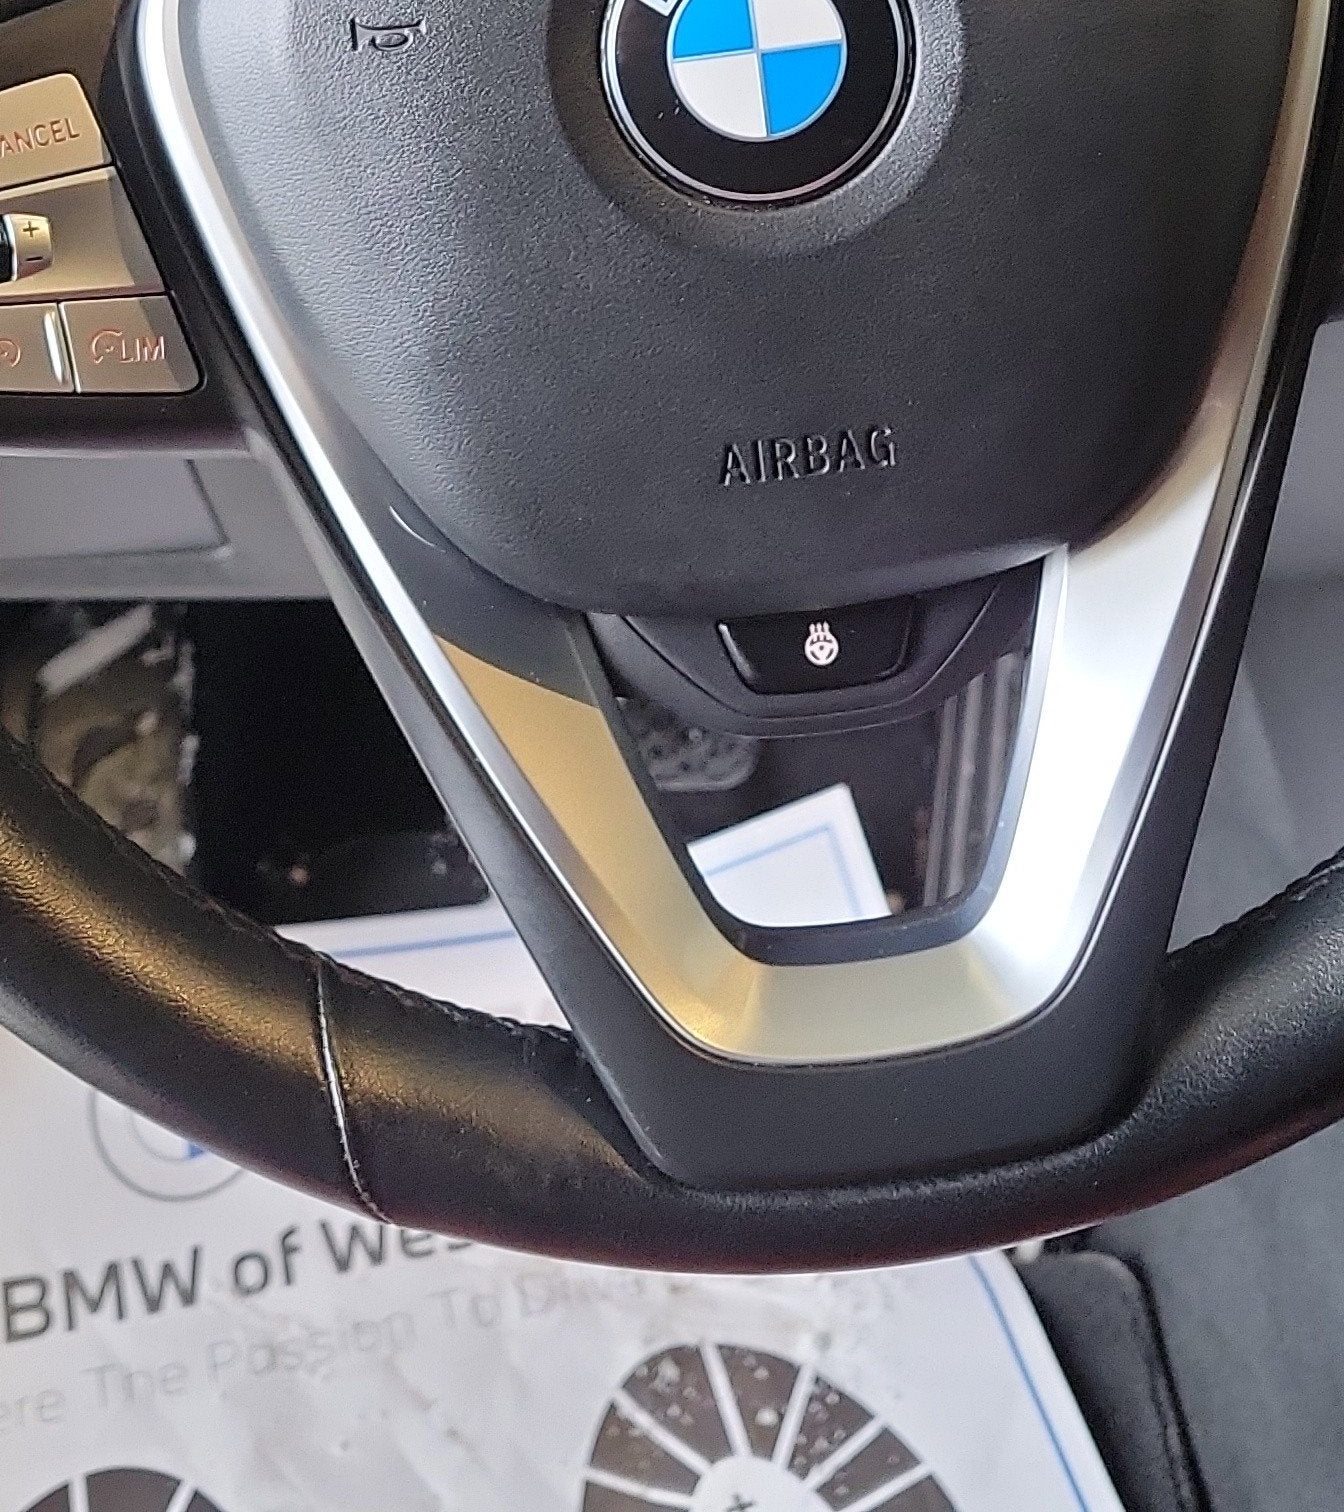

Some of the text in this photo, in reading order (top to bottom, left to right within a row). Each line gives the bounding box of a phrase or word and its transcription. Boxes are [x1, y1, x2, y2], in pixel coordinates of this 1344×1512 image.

[120, 336, 166, 363] LIM
[717, 425, 902, 489] AIRBAG
[0, 1217, 473, 1344] BMW of We
[82, 1358, 191, 1409] The
[206, 1303, 418, 1381] Passion
[426, 1284, 504, 1330] To
